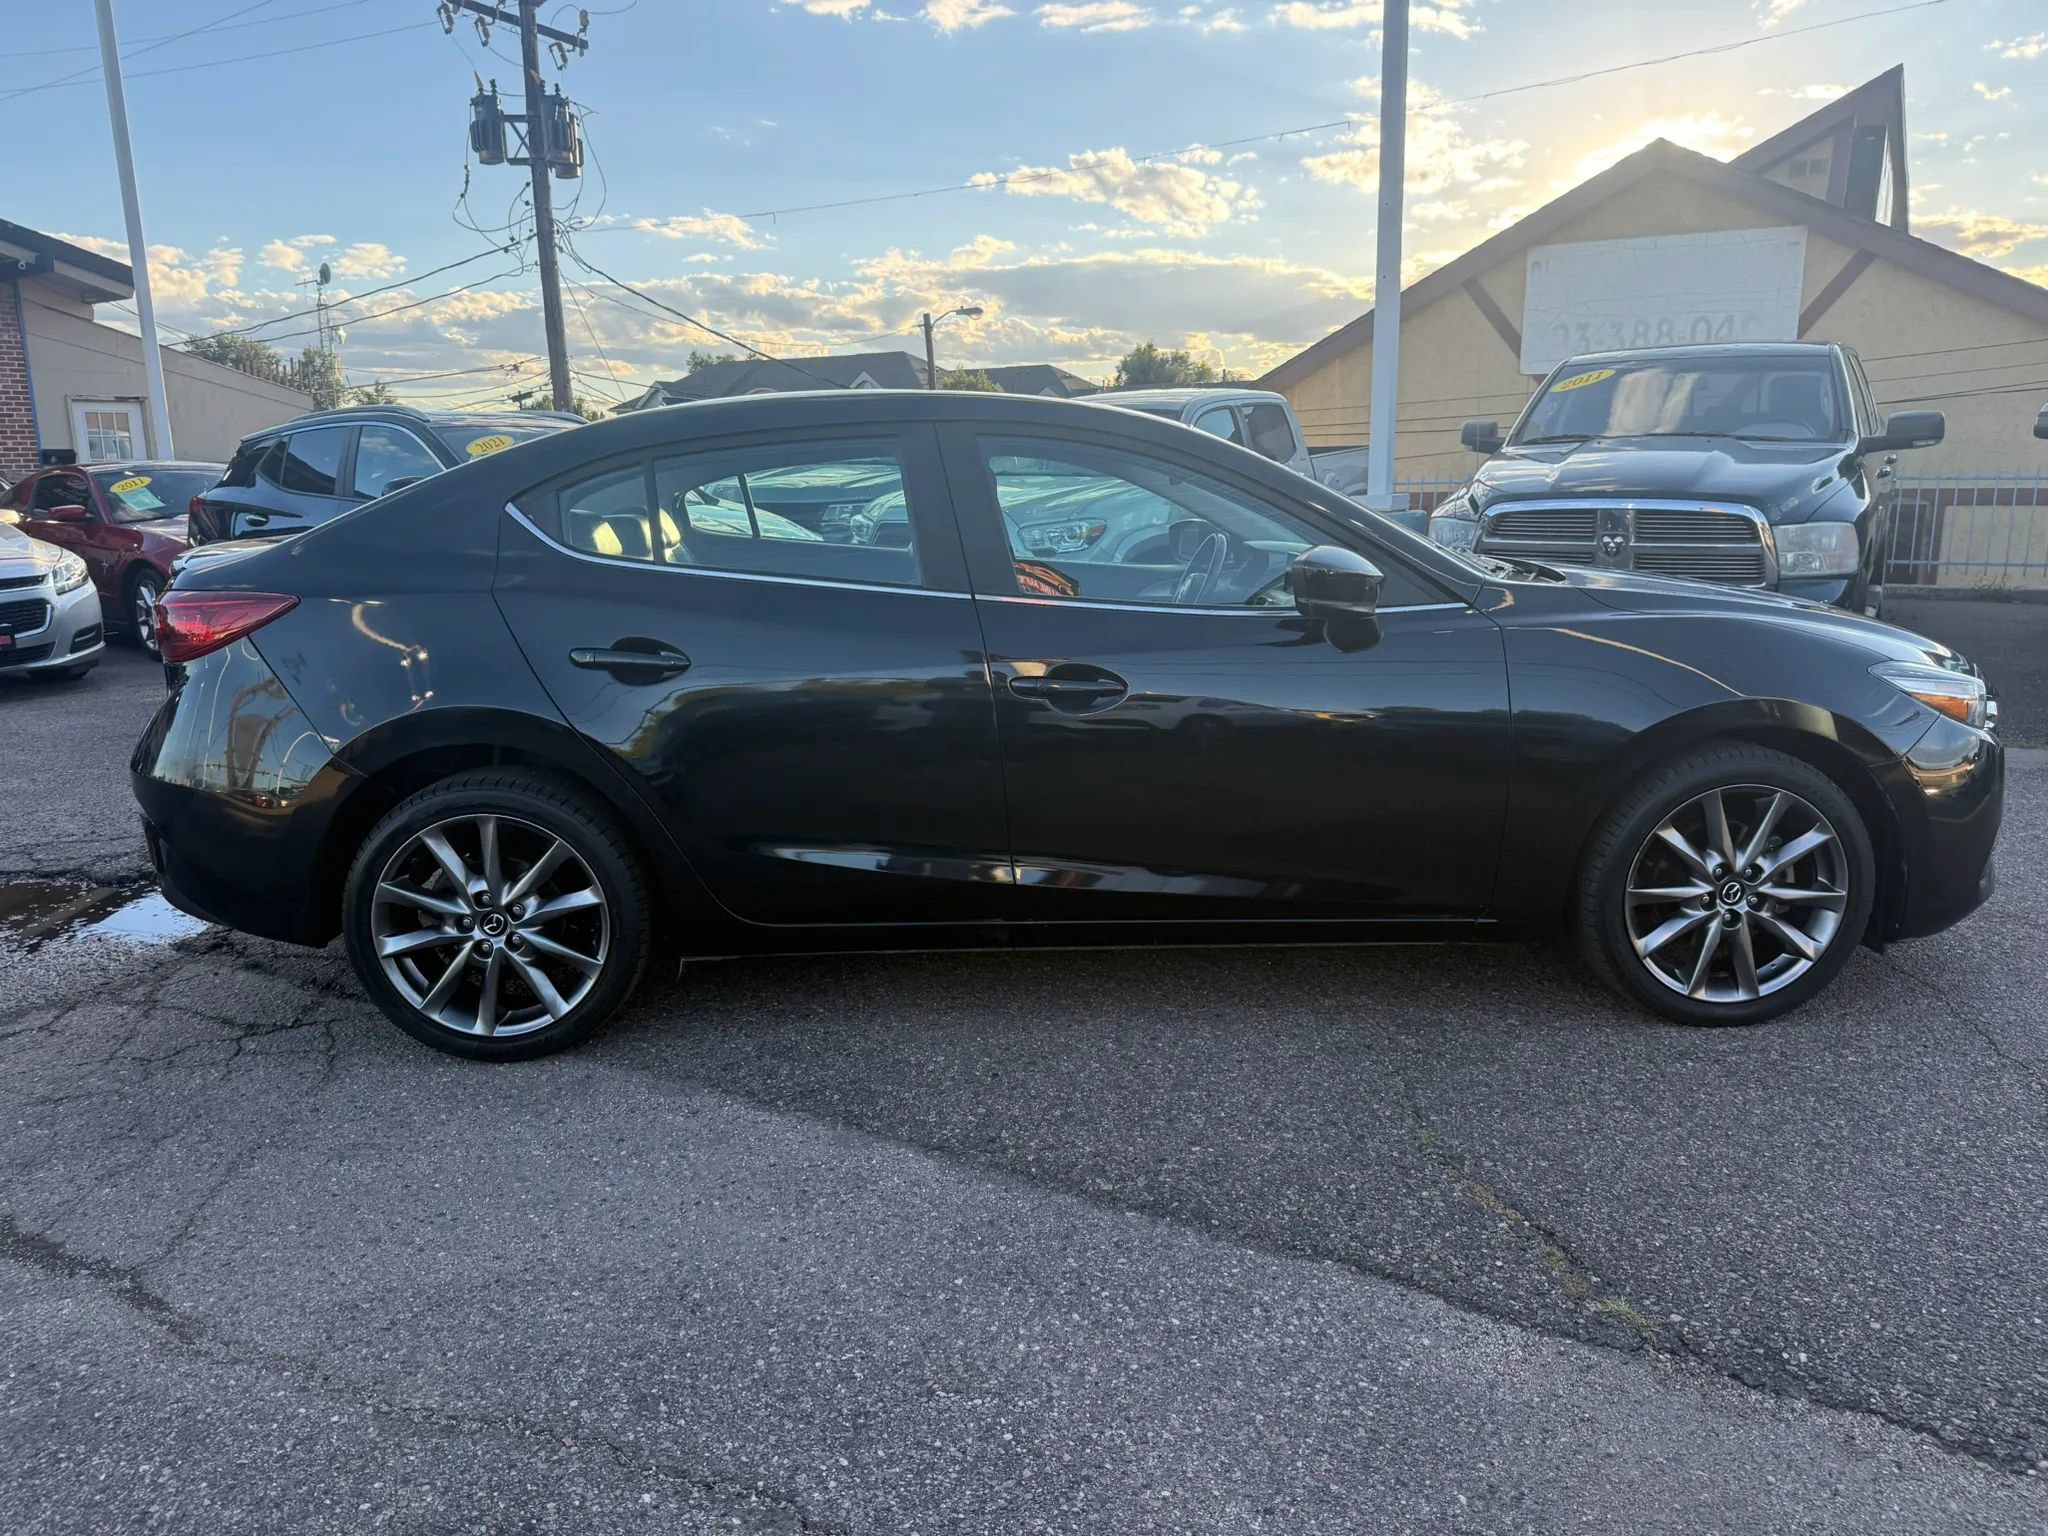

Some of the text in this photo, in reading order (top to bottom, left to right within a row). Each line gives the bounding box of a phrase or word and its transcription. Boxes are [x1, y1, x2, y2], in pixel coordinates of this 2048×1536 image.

[1559, 371, 1604, 390] 2011
[474, 436, 505, 453] 2021
[116, 478, 145, 491] 2011
